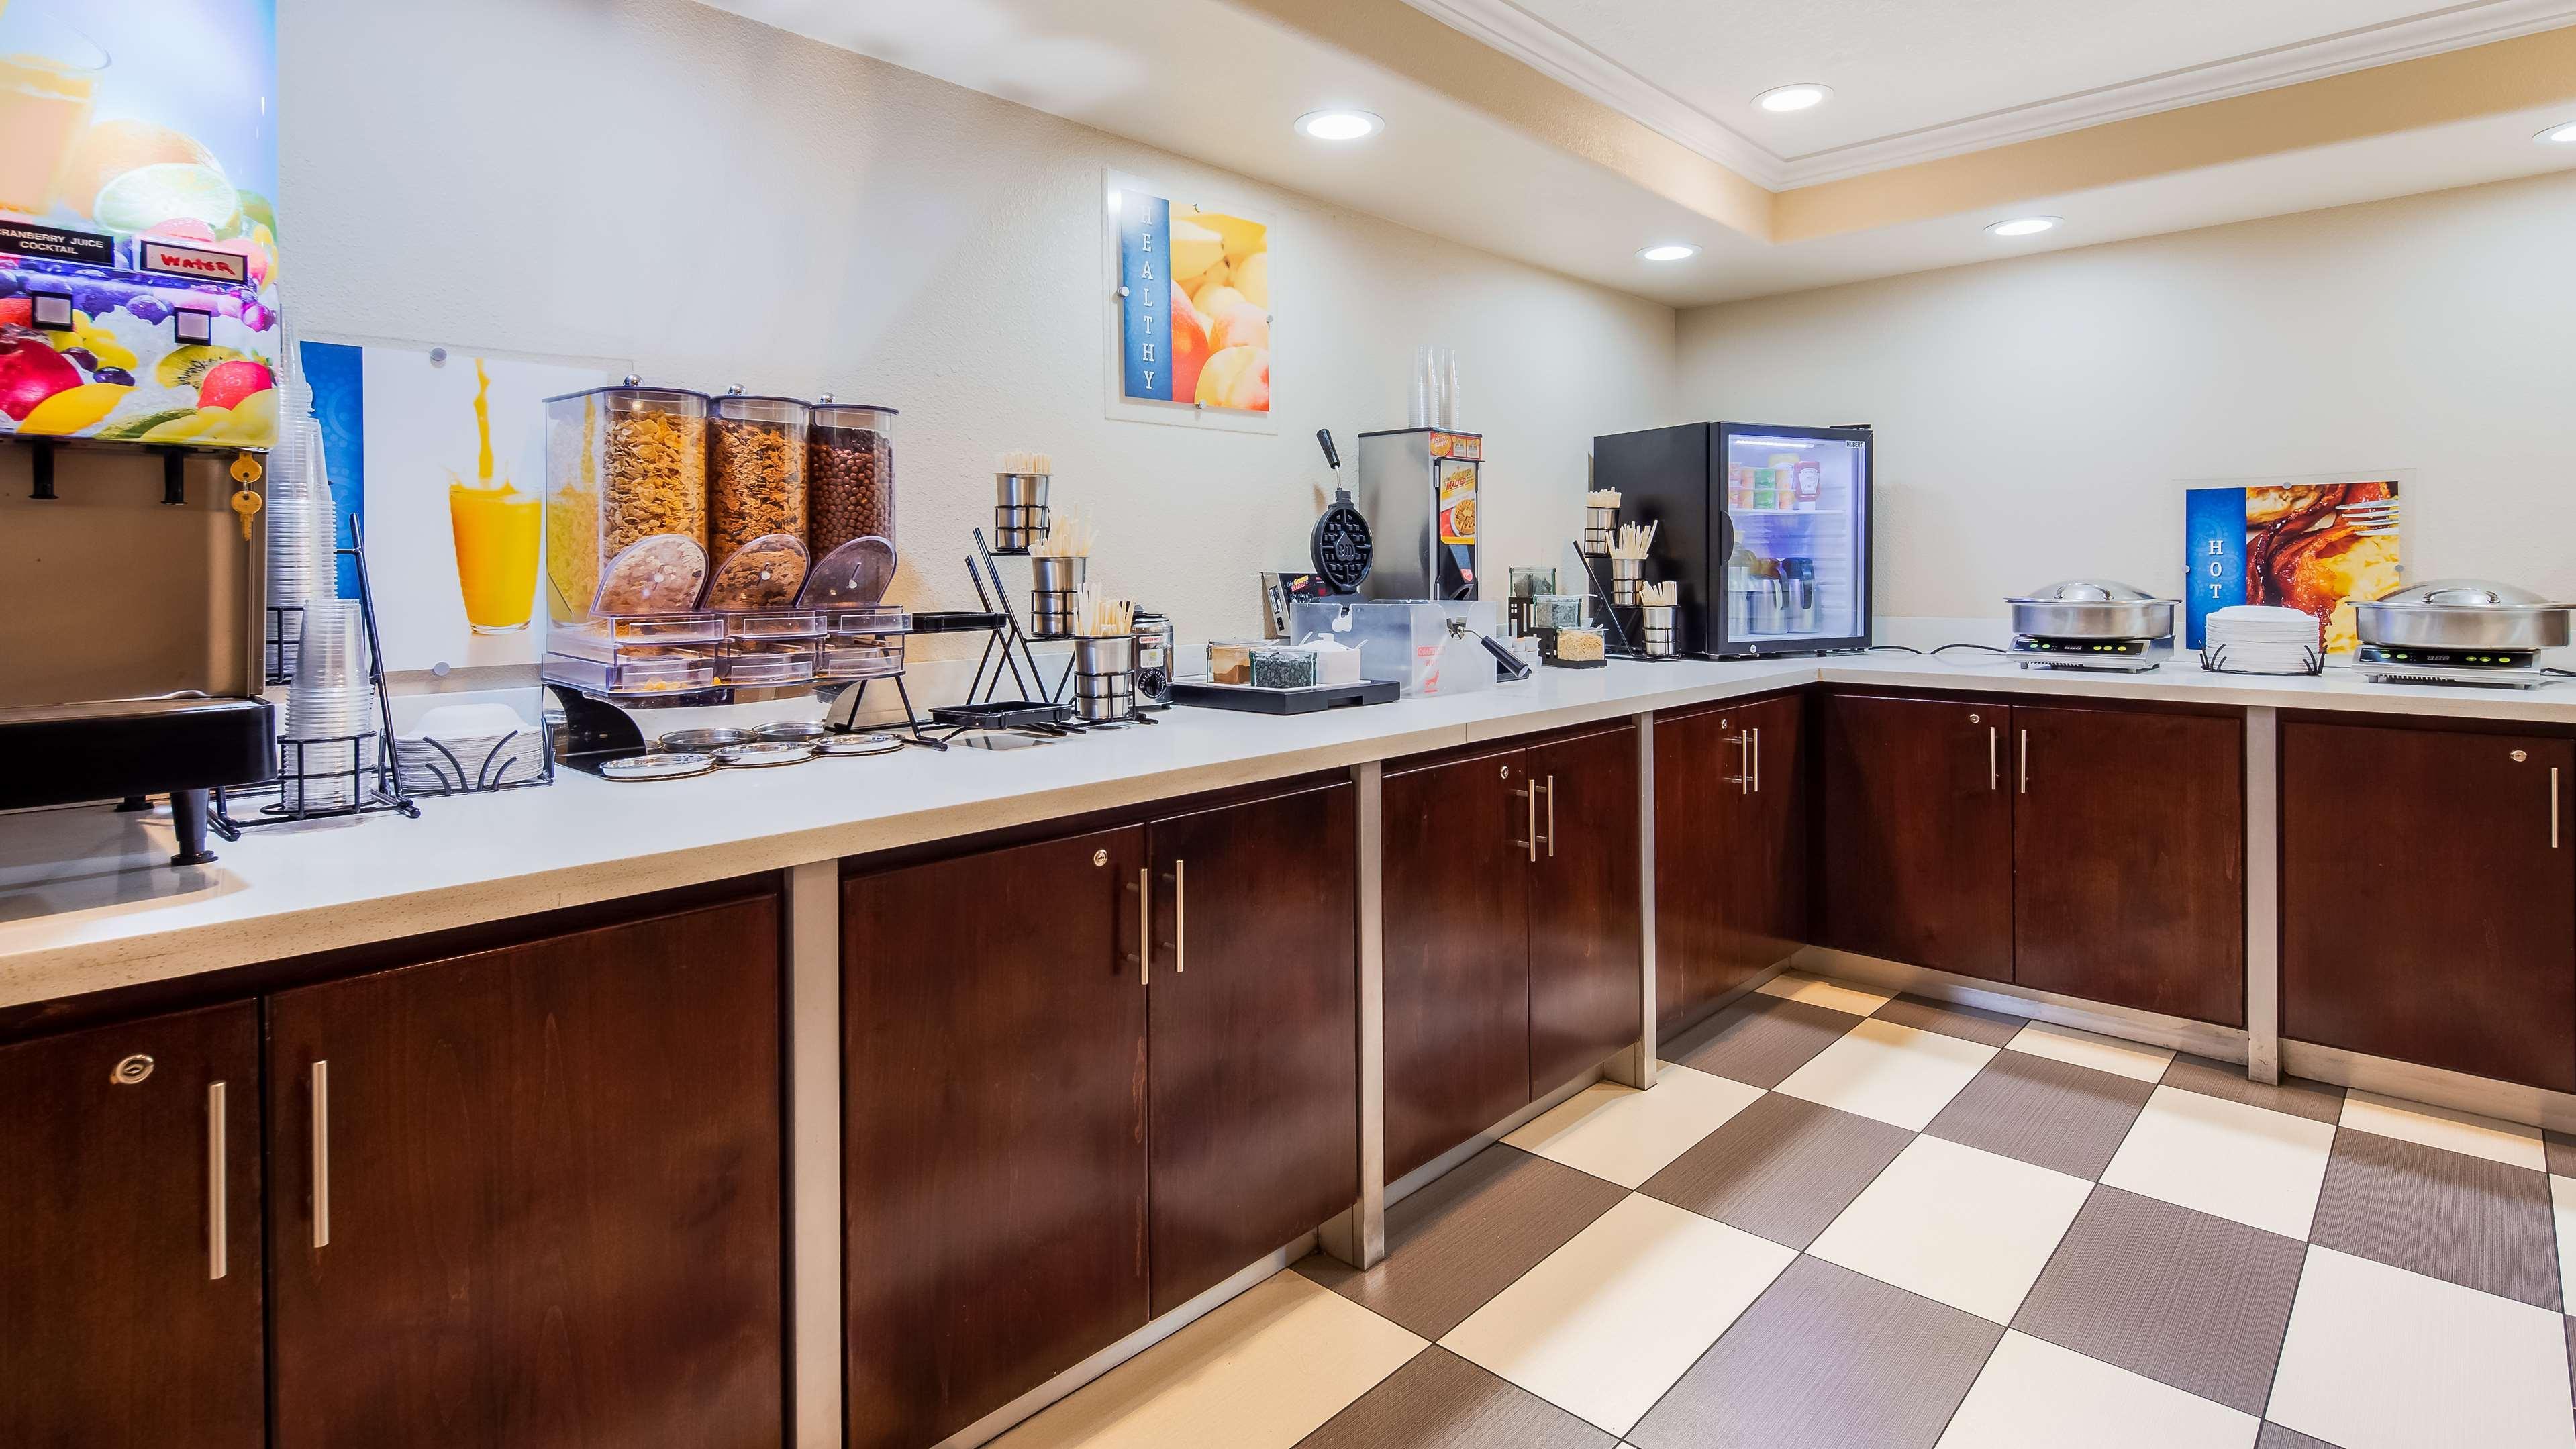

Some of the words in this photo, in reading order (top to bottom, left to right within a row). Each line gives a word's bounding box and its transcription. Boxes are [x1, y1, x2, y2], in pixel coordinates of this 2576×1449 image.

[20, 241, 79, 254] COCKTAIL
[70, 238, 103, 248] JUICE
[1142, 206, 1154, 389] HEALTHY
[2208, 540, 2223, 599] HOT
